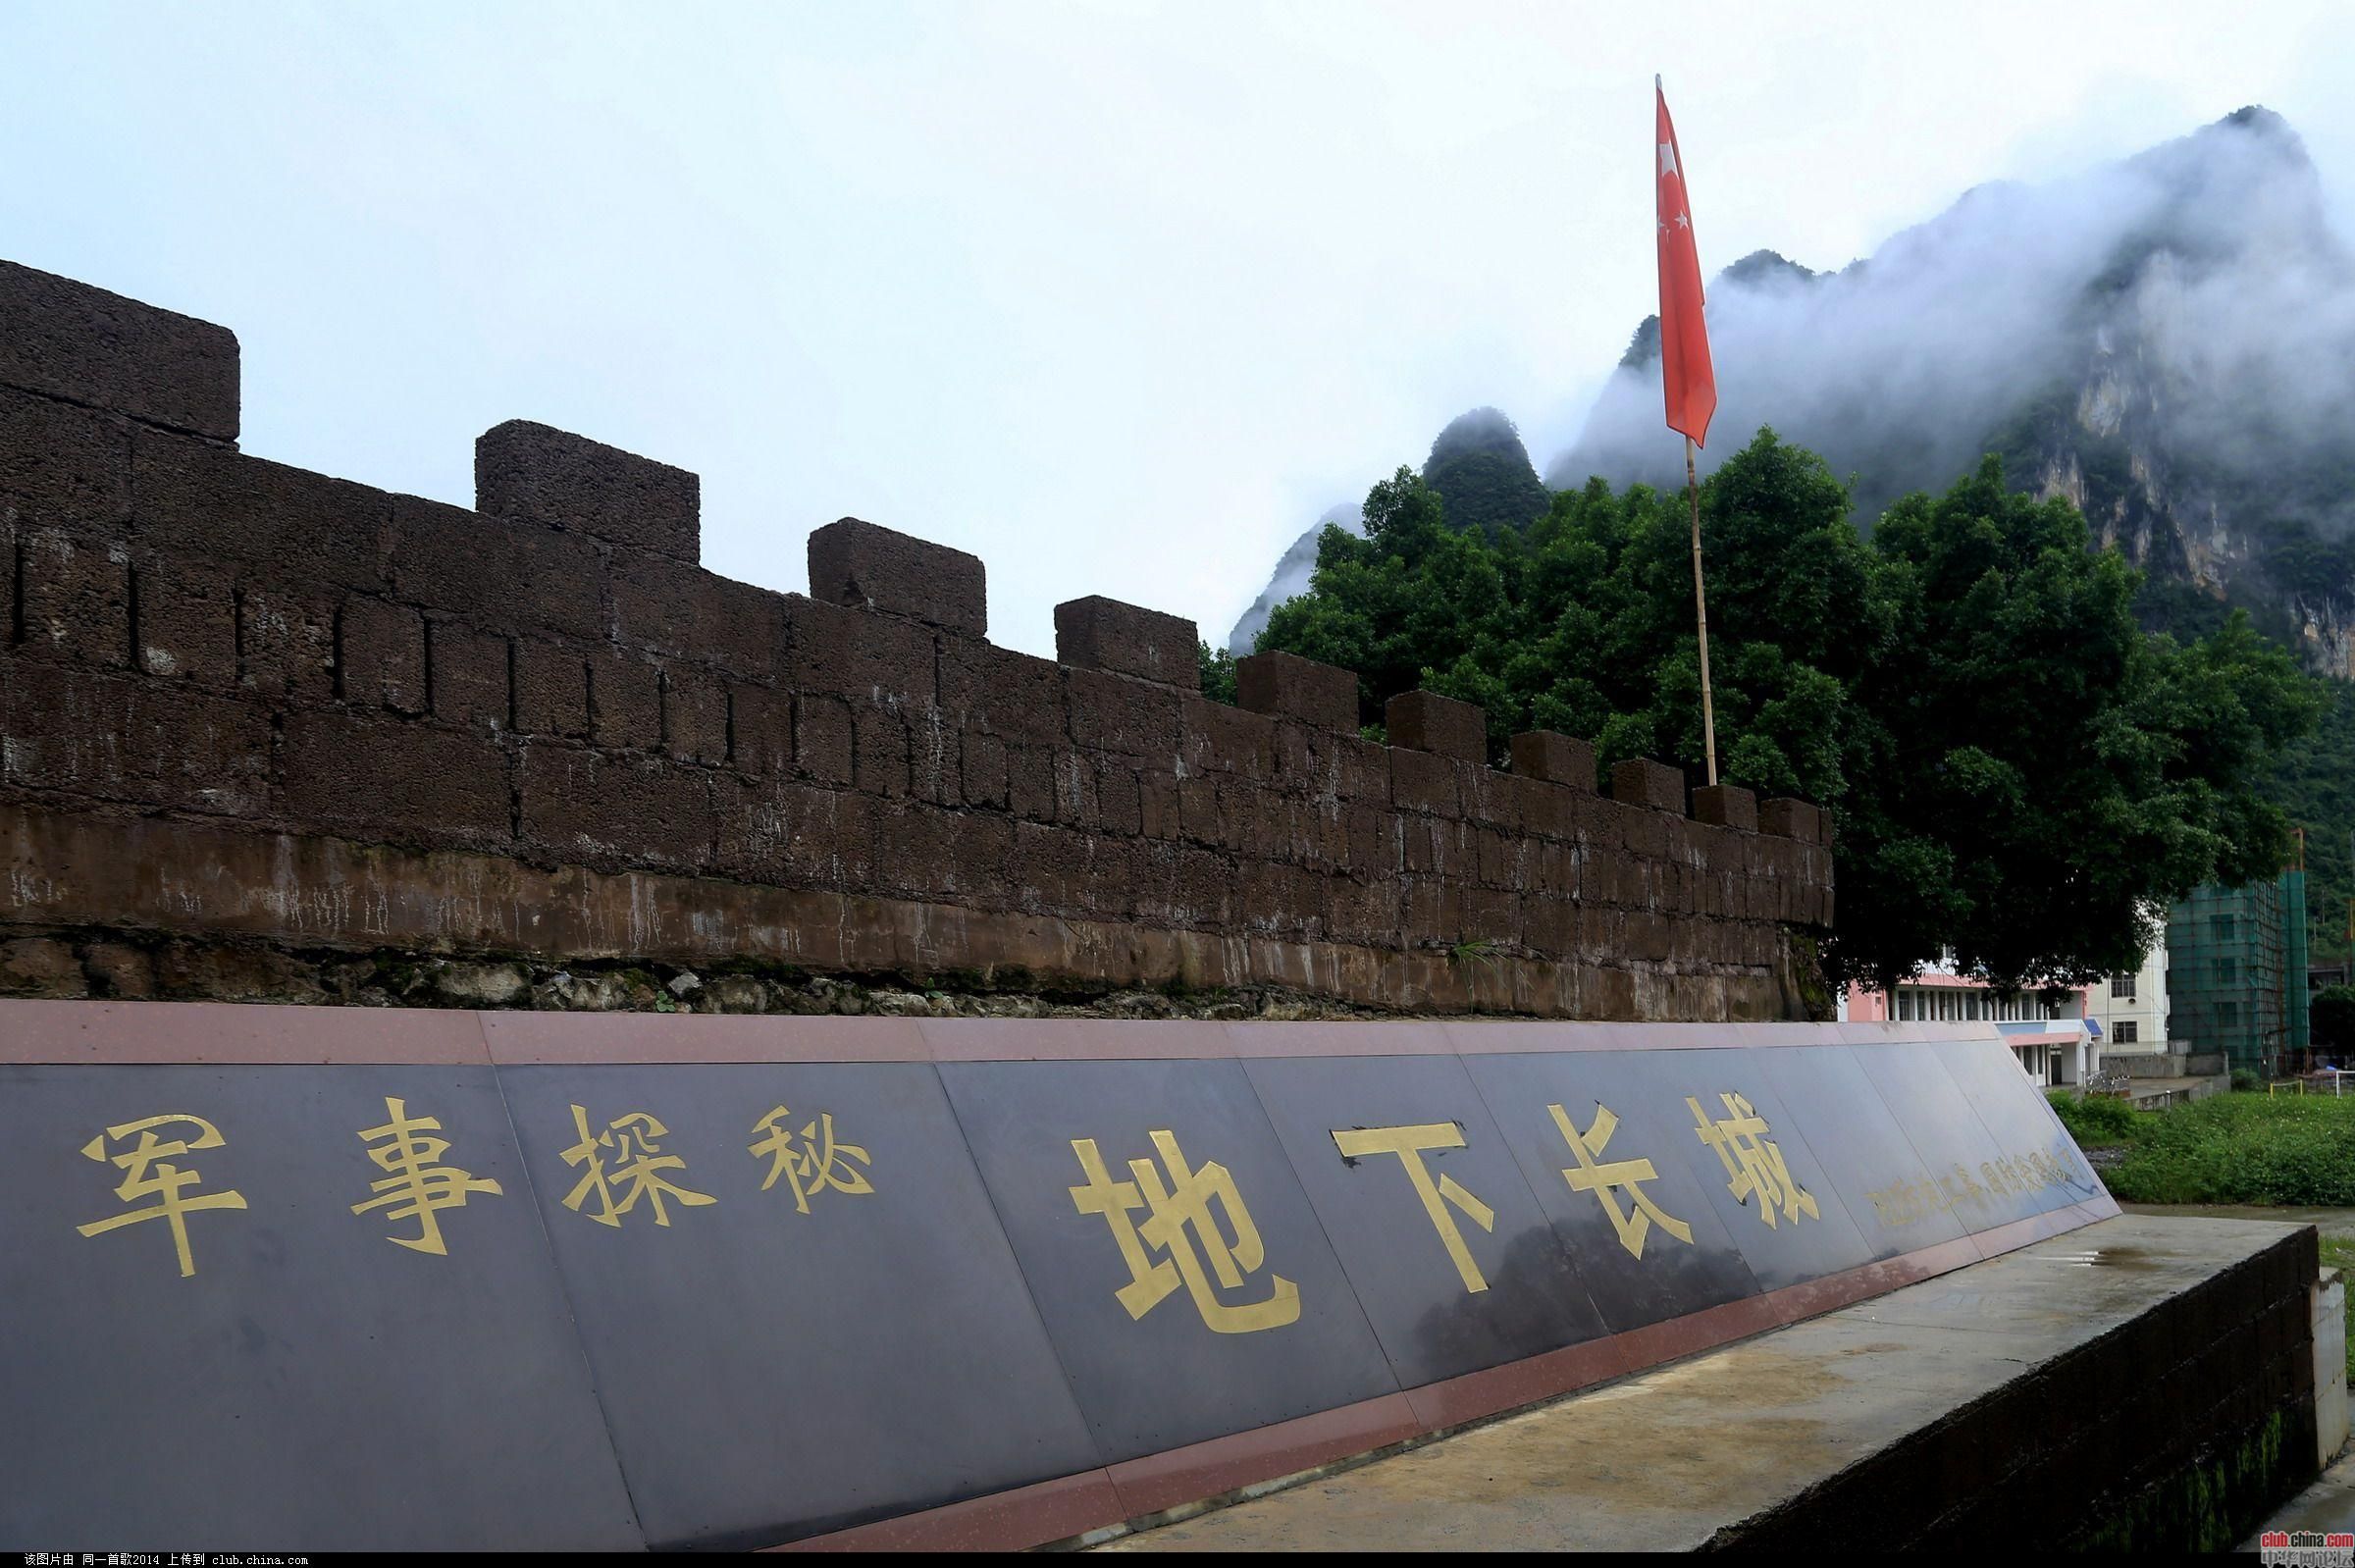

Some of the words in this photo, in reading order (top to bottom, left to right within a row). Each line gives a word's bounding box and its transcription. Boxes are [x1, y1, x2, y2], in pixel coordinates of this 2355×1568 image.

[77, 1096, 875, 1279] 军事探秘
[1068, 1090, 1820, 1334] 地下长城
